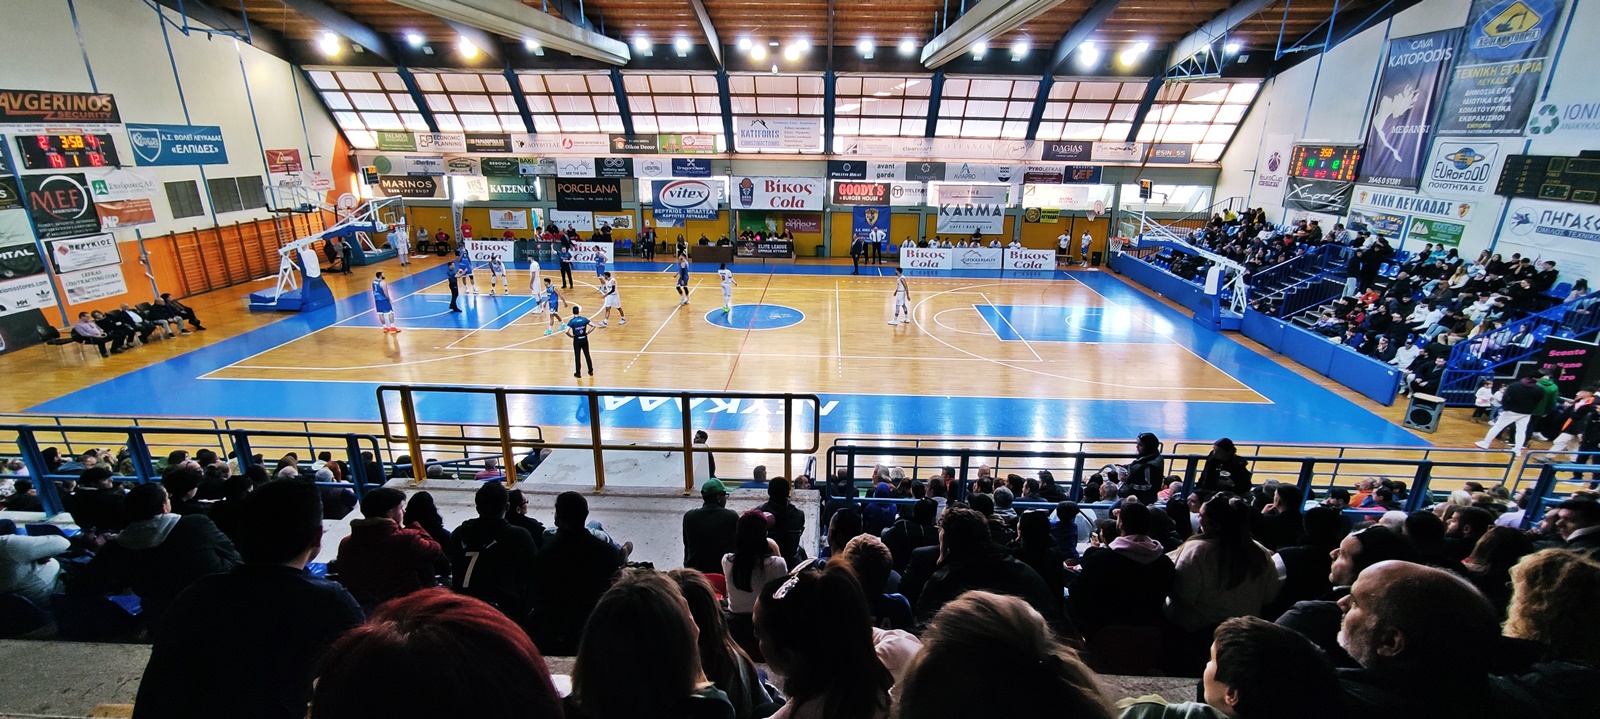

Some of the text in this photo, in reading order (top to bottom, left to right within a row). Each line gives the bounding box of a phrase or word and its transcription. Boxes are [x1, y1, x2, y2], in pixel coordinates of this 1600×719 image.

[1411, 38, 1434, 51] CAVA
[1388, 48, 1453, 68] KATOPODIS
[1456, 62, 1543, 79] ΤΕΧΝΙΚΗ ΕΤΑΙΡΙΑ
[0, 92, 113, 112] AVGERINOS
[57, 111, 112, 119] SECURITY
[741, 129, 780, 138] KATIFORIS
[434, 139, 463, 147] PLANNING
[382, 180, 432, 188] MARINOS
[490, 184, 534, 194] ΚΑΤΣΕΝΟΣ
[558, 183, 618, 194] PORCELANA
[765, 179, 812, 195] Βίκος
[1428, 181, 1469, 191] ΠΟΙΟΤΗΤΑ
[669, 187, 704, 198] vitex
[839, 183, 885, 196] GOODY'S
[31, 189, 80, 211] MEF
[770, 196, 805, 208] Cola
[1370, 193, 1453, 216] ΝΙΚΗ ΛΕΥΚΑΔΑΣ
[939, 203, 1002, 217] KARMA
[1537, 226, 1565, 236] ΟΜΙΛΟΣ
[471, 242, 507, 251] Βίκος
[574, 253, 597, 262] Col
[906, 250, 945, 260] Βίκος
[1009, 251, 1049, 261] Βίκος
[910, 260, 939, 268] Cola
[1013, 261, 1043, 269] Cola
[1549, 349, 1587, 357] Sconto
[462, 551, 480, 588] 7
